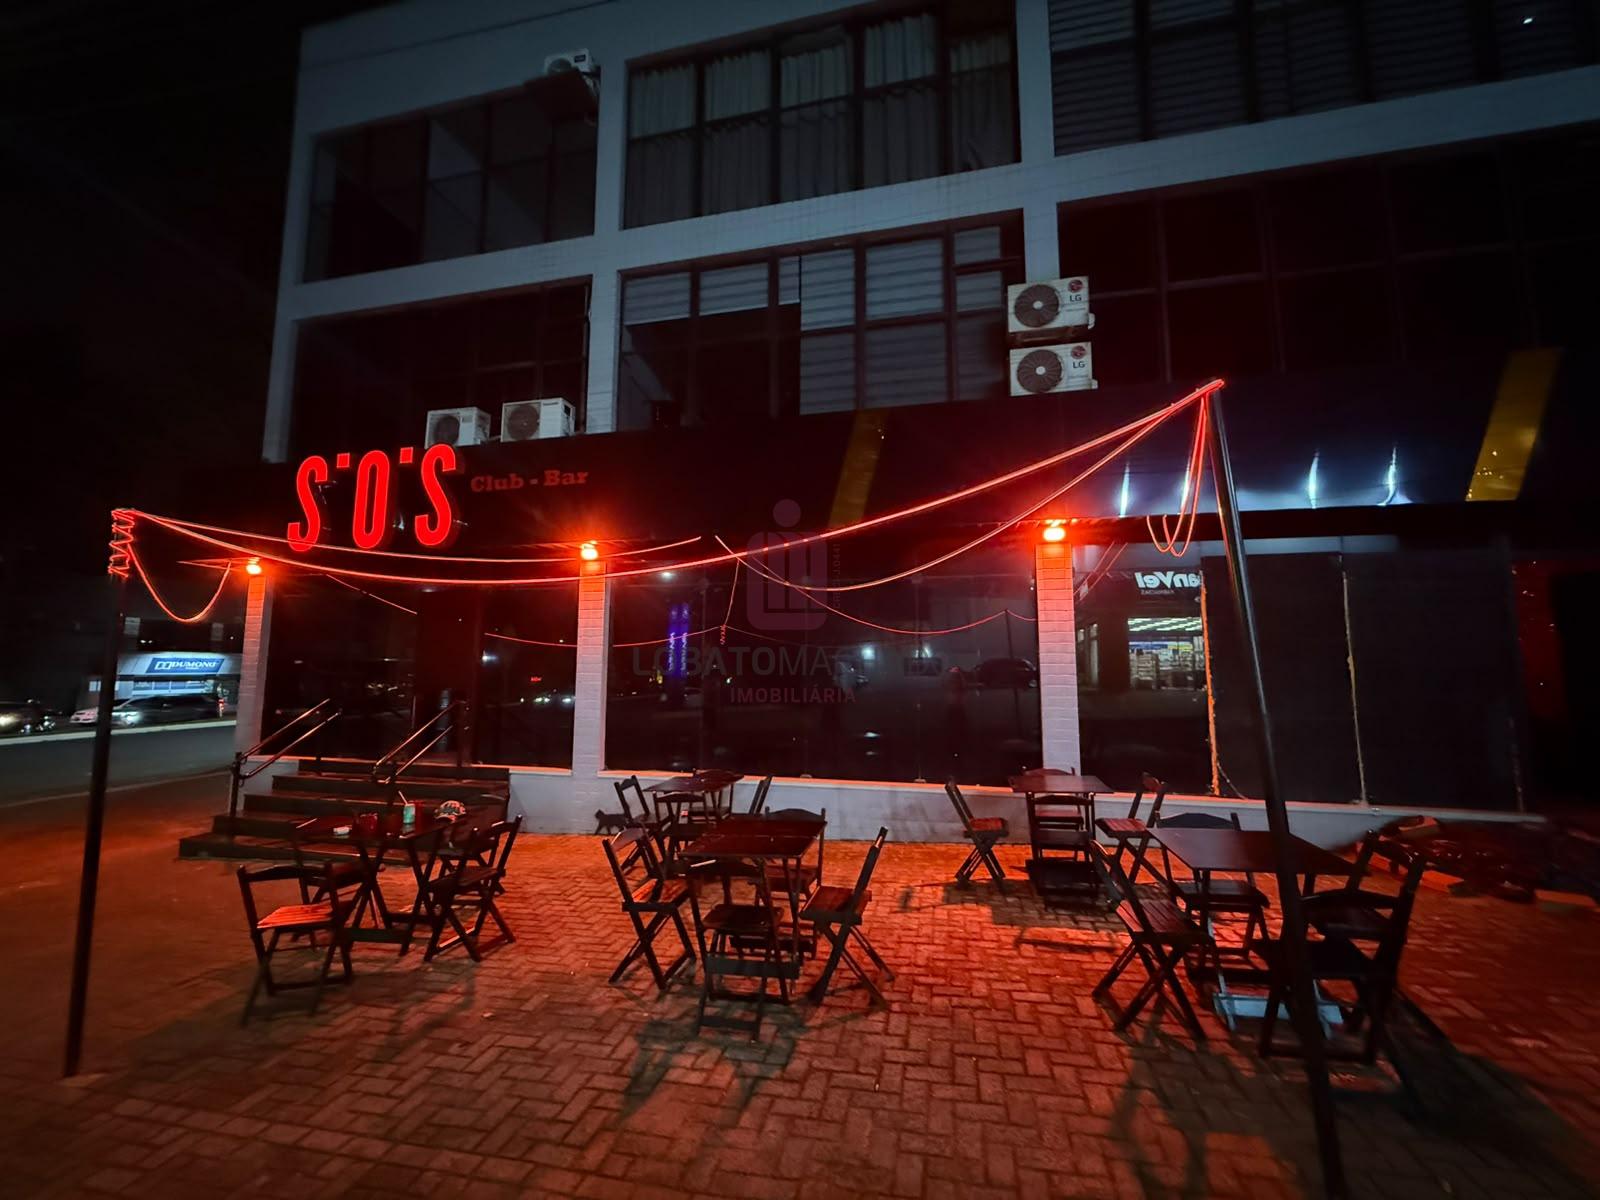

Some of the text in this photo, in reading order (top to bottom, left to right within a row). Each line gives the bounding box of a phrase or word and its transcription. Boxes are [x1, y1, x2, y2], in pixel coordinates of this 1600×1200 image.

[1069, 294, 1082, 303] LG
[1073, 361, 1085, 369] LG
[471, 473, 524, 493] Club
[544, 468, 590, 488] Bar
